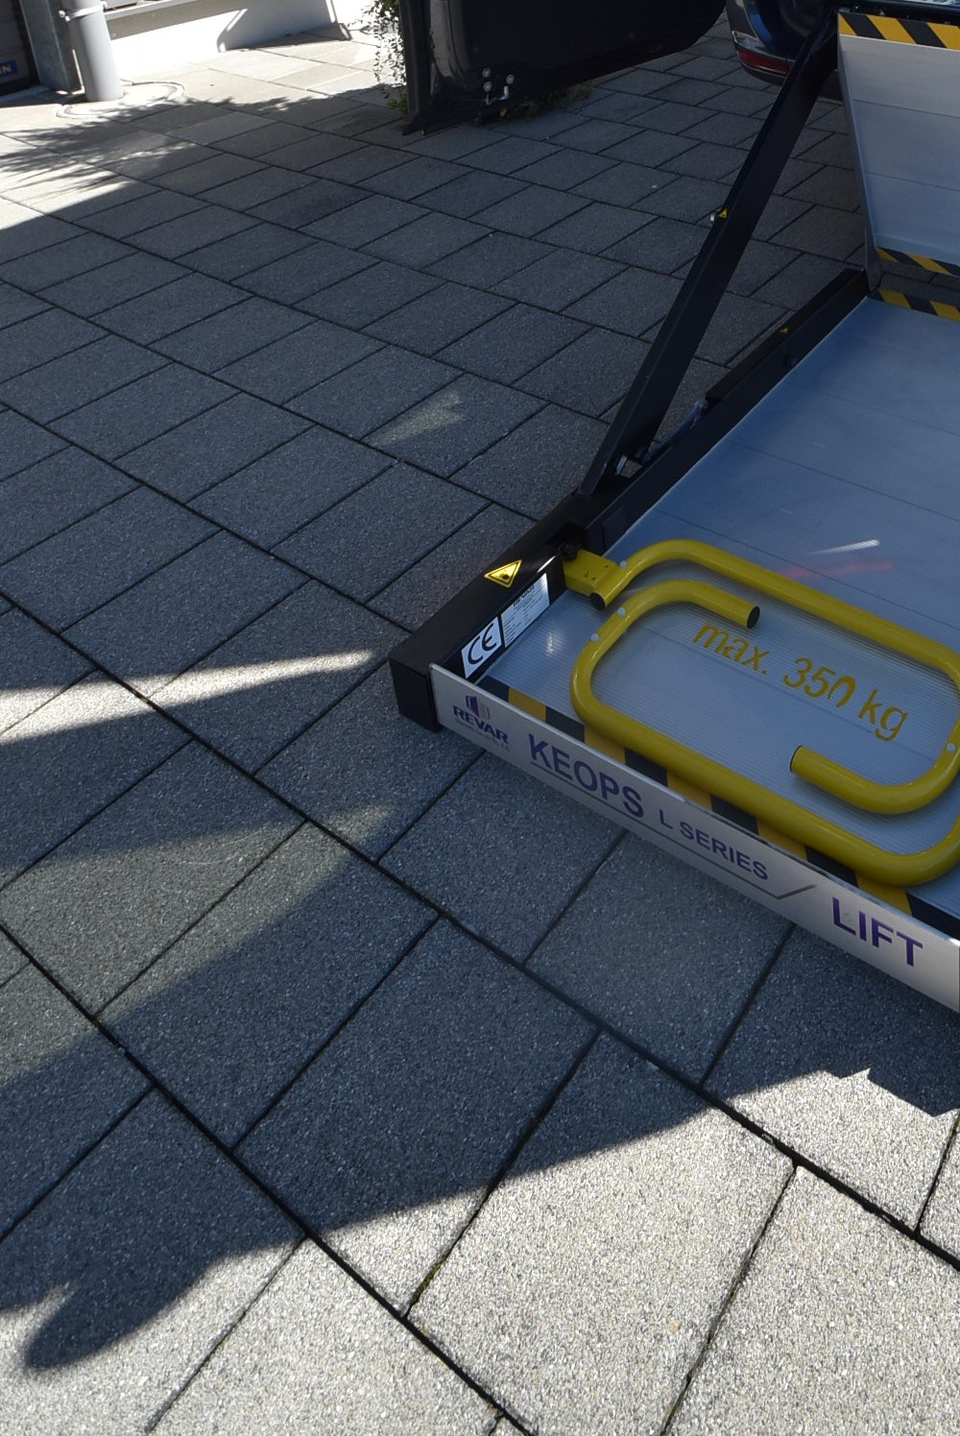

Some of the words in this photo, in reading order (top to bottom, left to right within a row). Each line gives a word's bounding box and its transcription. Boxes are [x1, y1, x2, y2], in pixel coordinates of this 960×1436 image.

[453, 705, 509, 745] REVAR
[692, 623, 769, 675] max.
[783, 657, 856, 708] 350
[858, 688, 908, 741] kg
[528, 733, 644, 818] KEOPS
[659, 809, 673, 830] L
[680, 821, 769, 881] SERIES
[832, 896, 924, 968] LIFT
